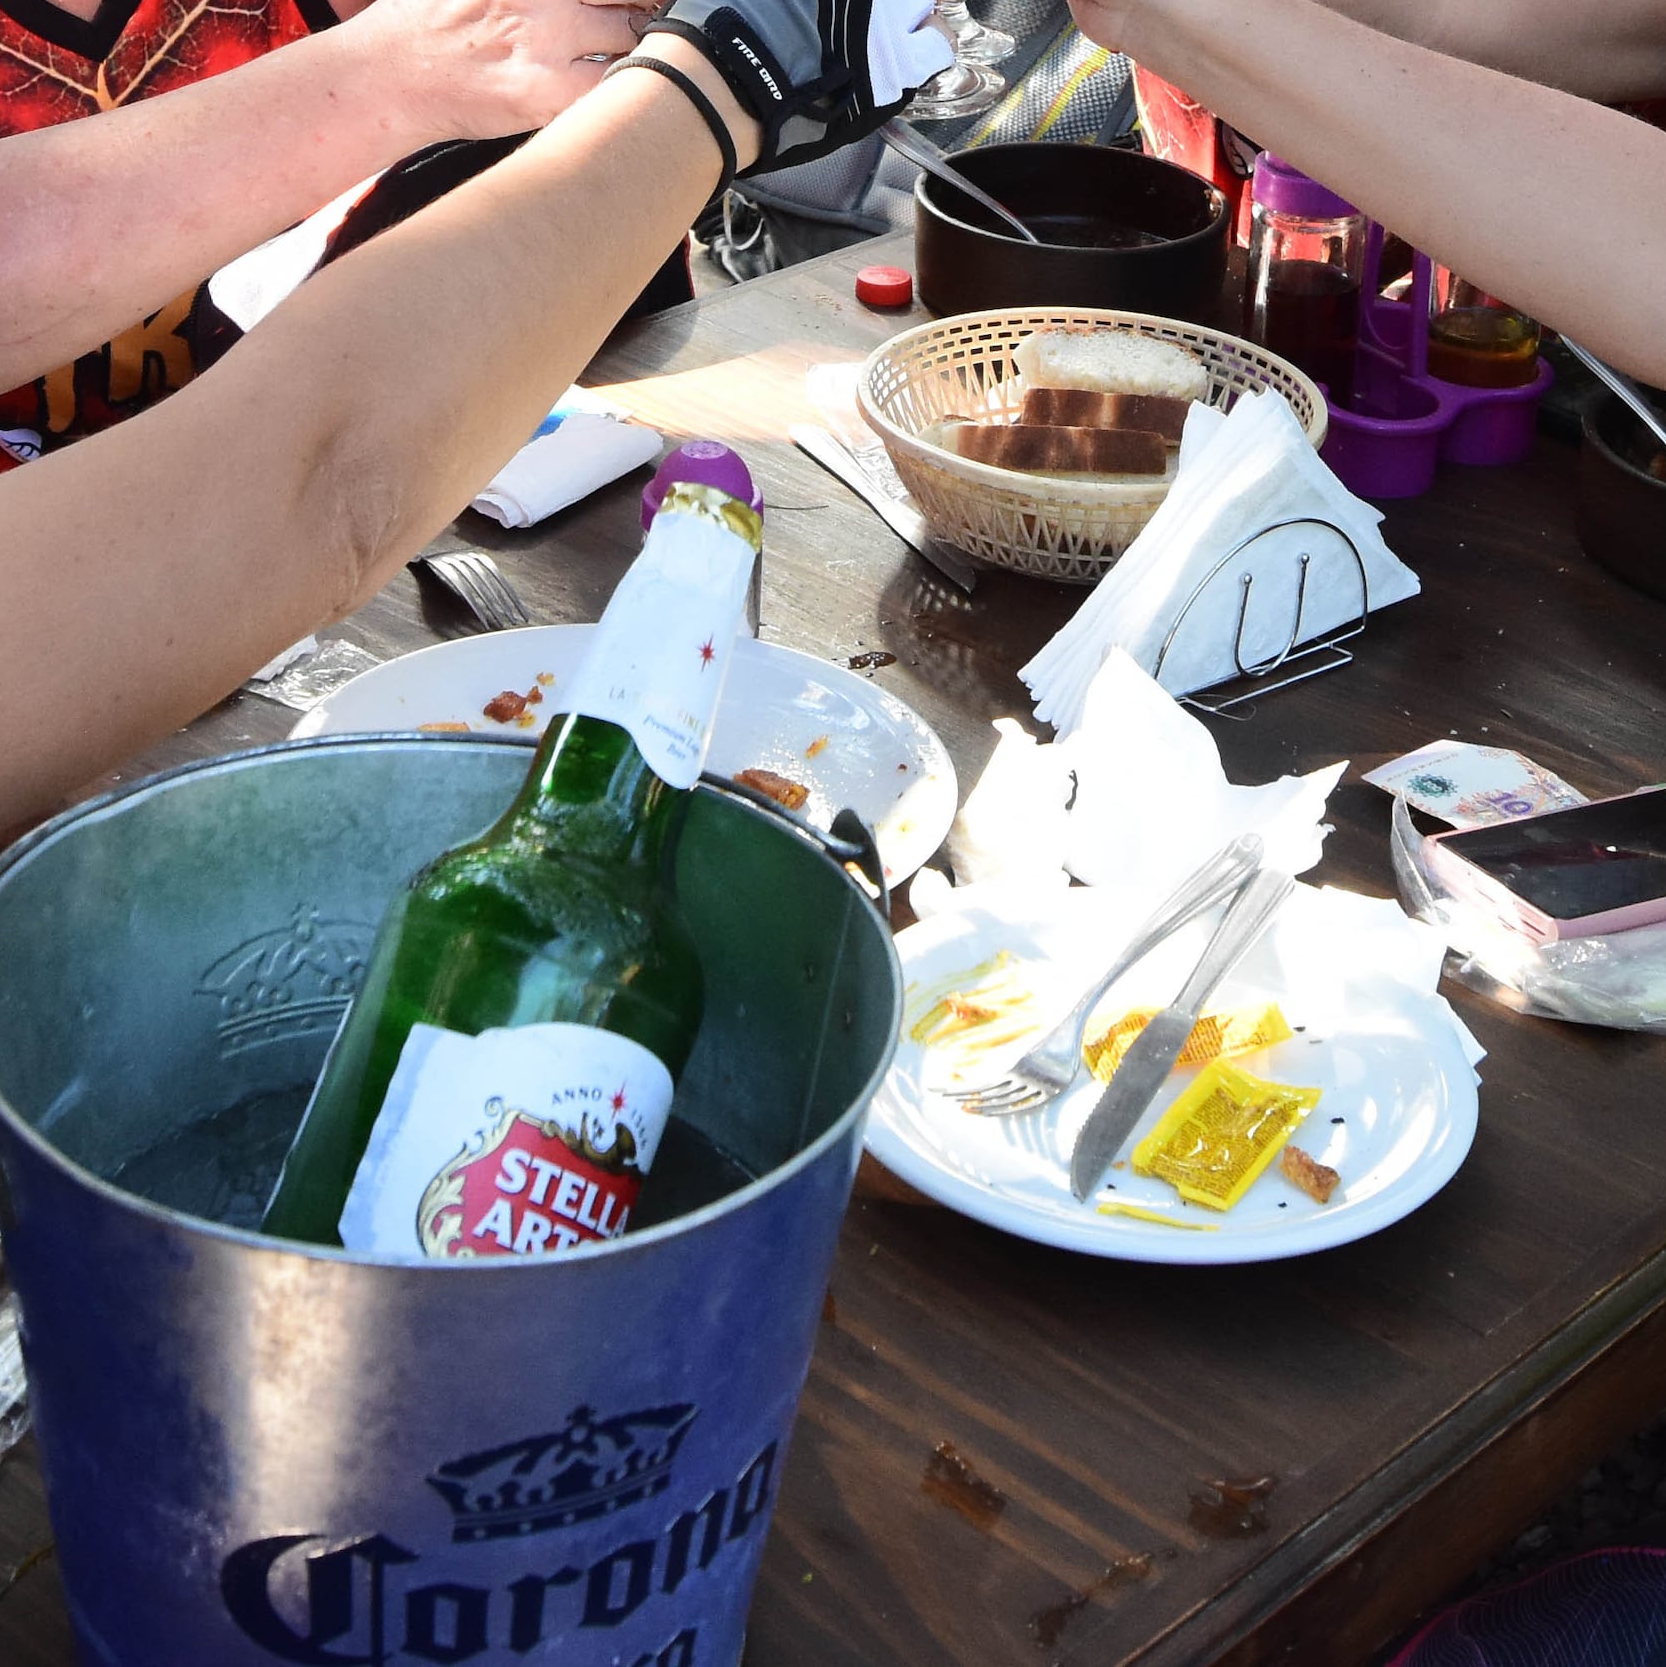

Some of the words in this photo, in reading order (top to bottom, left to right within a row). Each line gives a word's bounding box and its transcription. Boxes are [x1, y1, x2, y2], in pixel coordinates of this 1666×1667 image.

[731, 37, 762, 67] FIRE
[552, 1087, 603, 1105] ANNO
[494, 1148, 631, 1241] STELLA
[472, 1199, 601, 1253] ART
[219, 1440, 778, 1667] Corona
